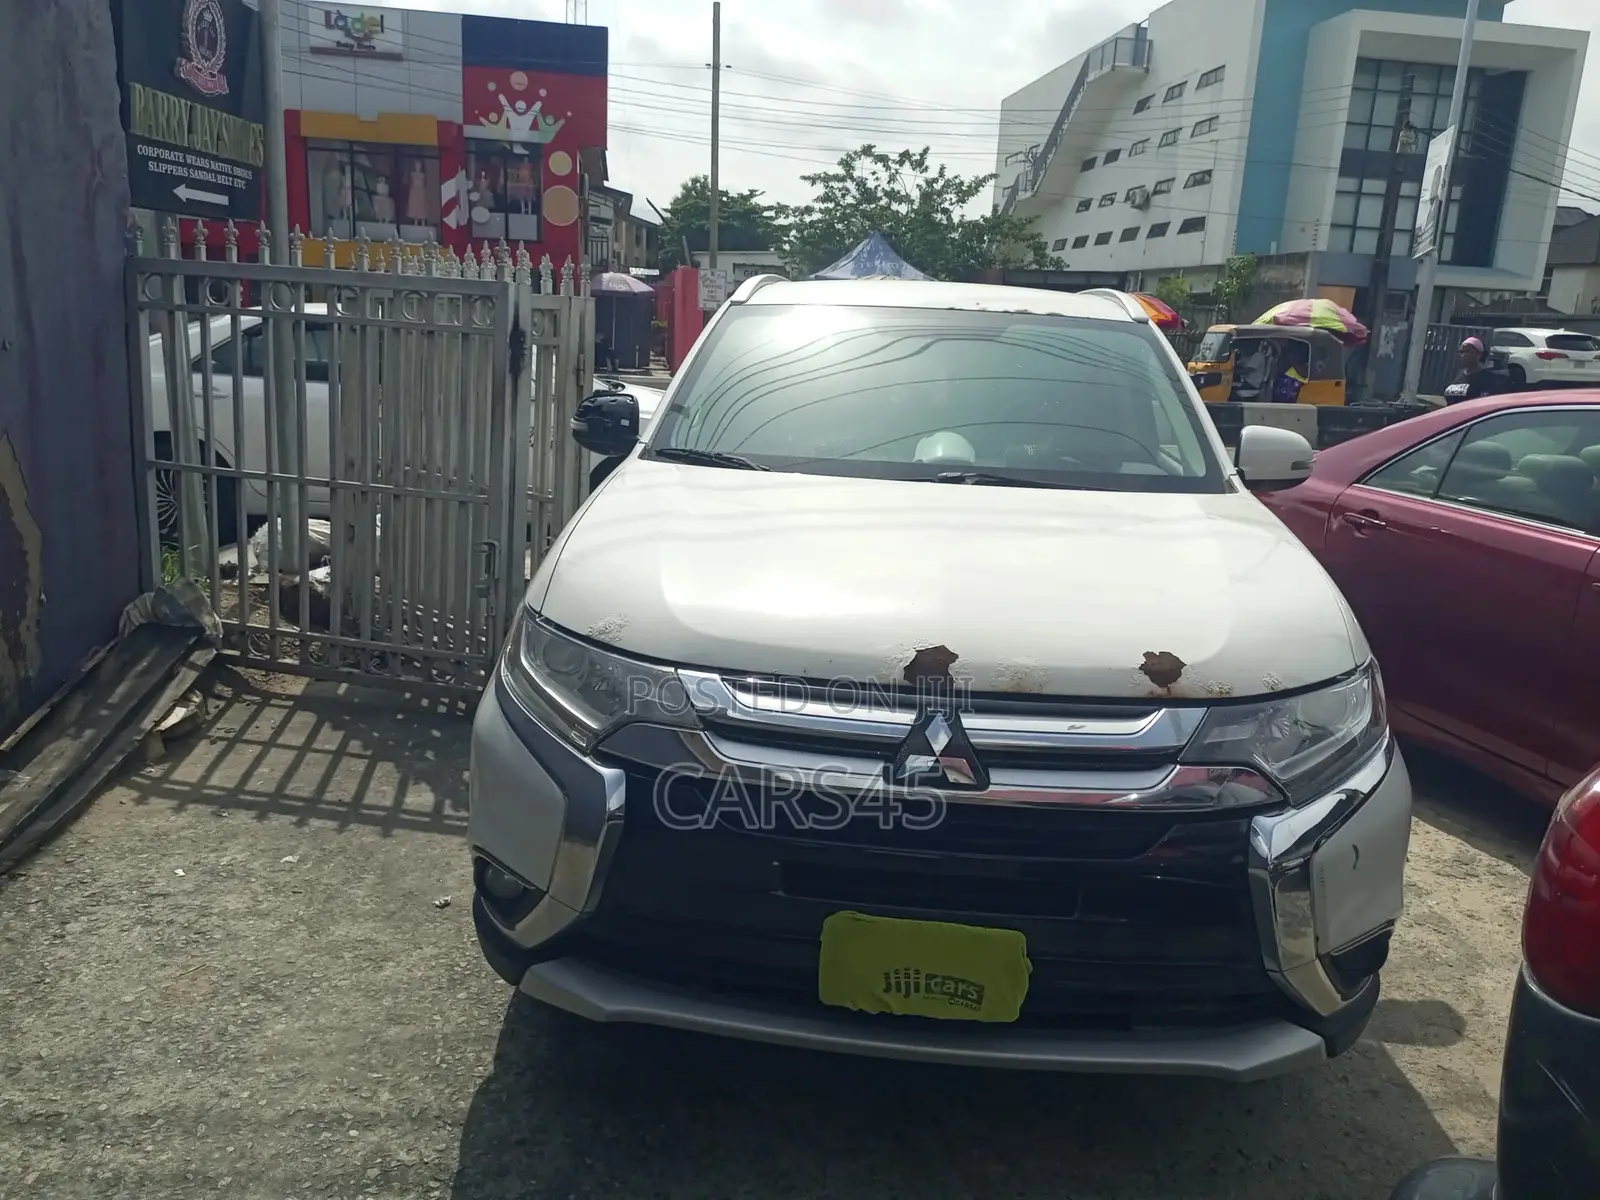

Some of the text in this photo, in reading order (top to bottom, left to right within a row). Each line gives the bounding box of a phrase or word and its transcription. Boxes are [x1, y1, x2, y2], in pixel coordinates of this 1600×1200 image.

[137, 144, 253, 180] CORPORATE WEARS NATIVE SHOES
[148, 160, 189, 178] SLIPPERS
[189, 168, 217, 182] SANDAL
[217, 175, 234, 186] BELT
[882, 966, 979, 1000] jiji cars
